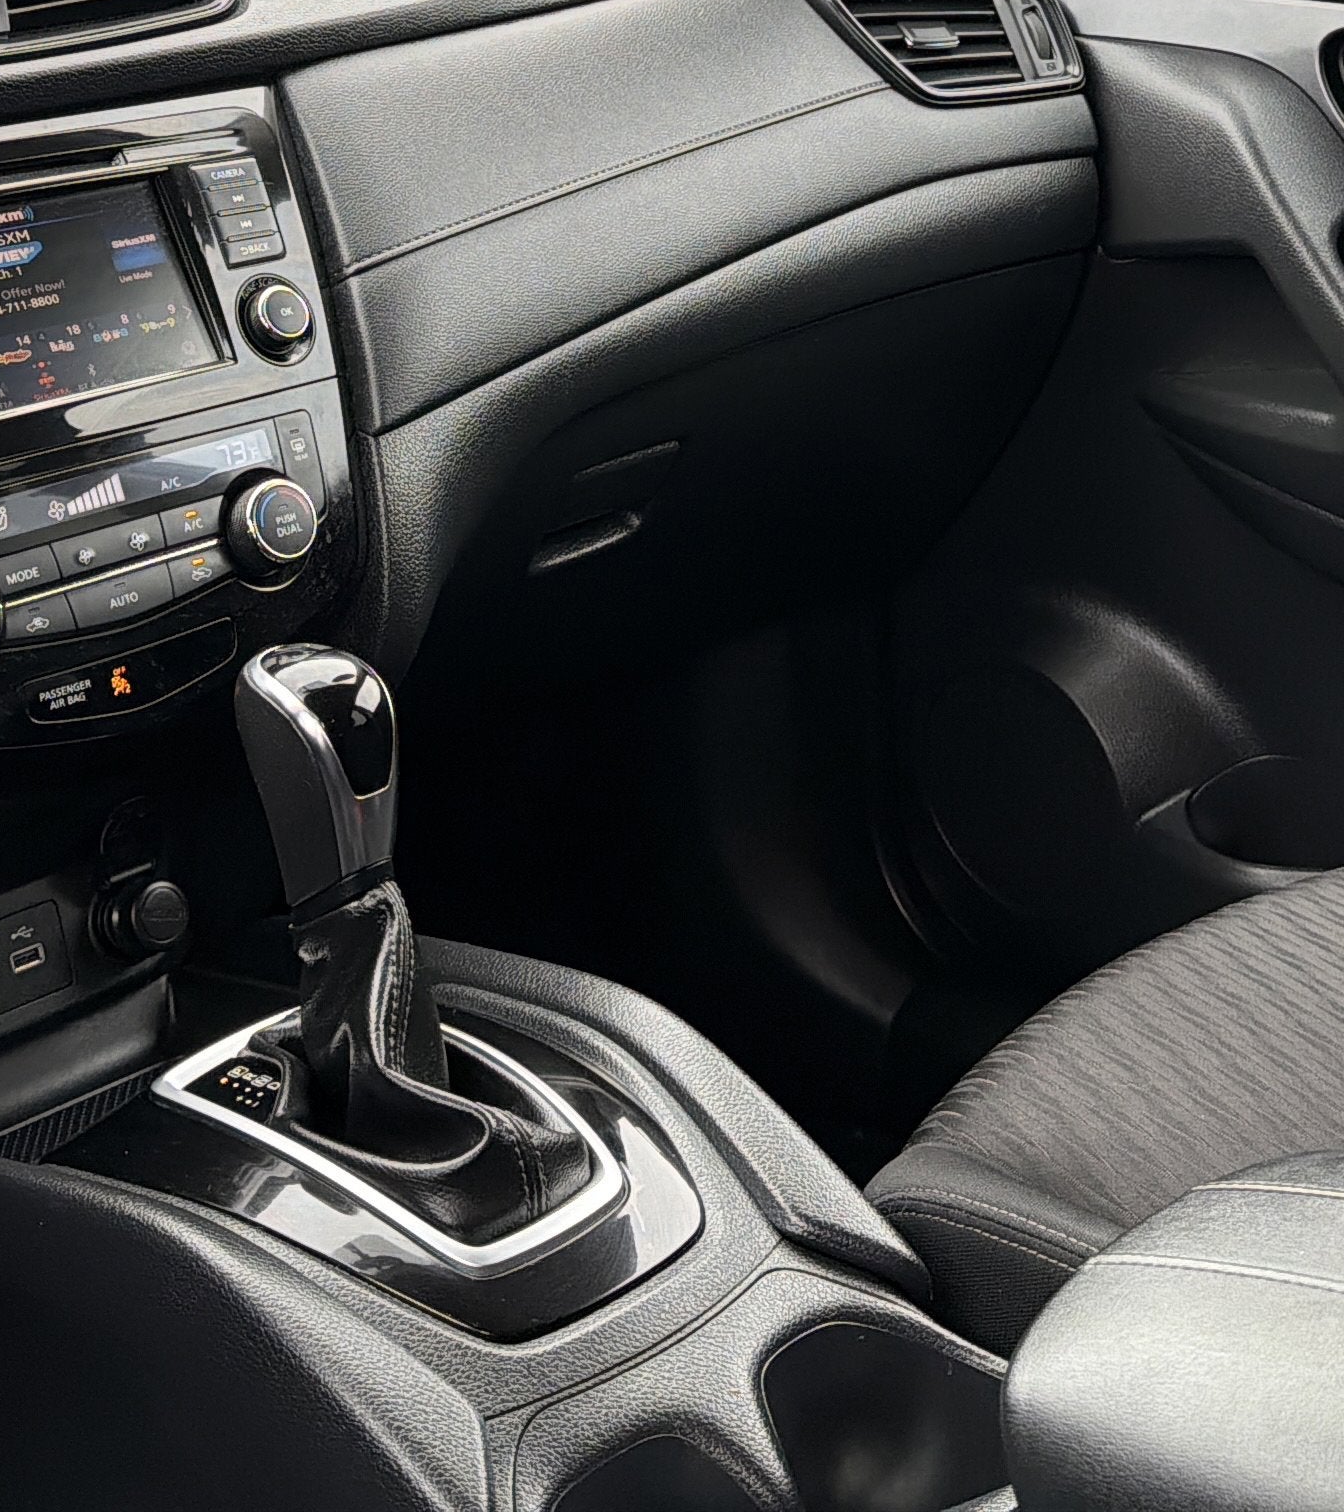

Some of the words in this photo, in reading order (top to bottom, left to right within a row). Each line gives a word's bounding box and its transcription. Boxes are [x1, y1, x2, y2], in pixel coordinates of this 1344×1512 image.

[211, 167, 247, 180] CAMERA
[248, 242, 272, 254] BACK
[1, 284, 33, 300] Offer
[34, 278, 66, 293] Now!
[280, 306, 294, 317] OK
[65, 324, 81, 336] 18
[15, 334, 32, 347] 14
[161, 475, 182, 492] A/C
[183, 518, 204, 533] A/C
[275, 512, 297, 526] PUSH
[276, 523, 304, 538] DUAL
[6, 566, 40, 586] MODE
[109, 591, 139, 609] AUTO
[39, 679, 92, 703] PASSENGER
[50, 698, 66, 711] AIR
[67, 692, 86, 705] BAG
